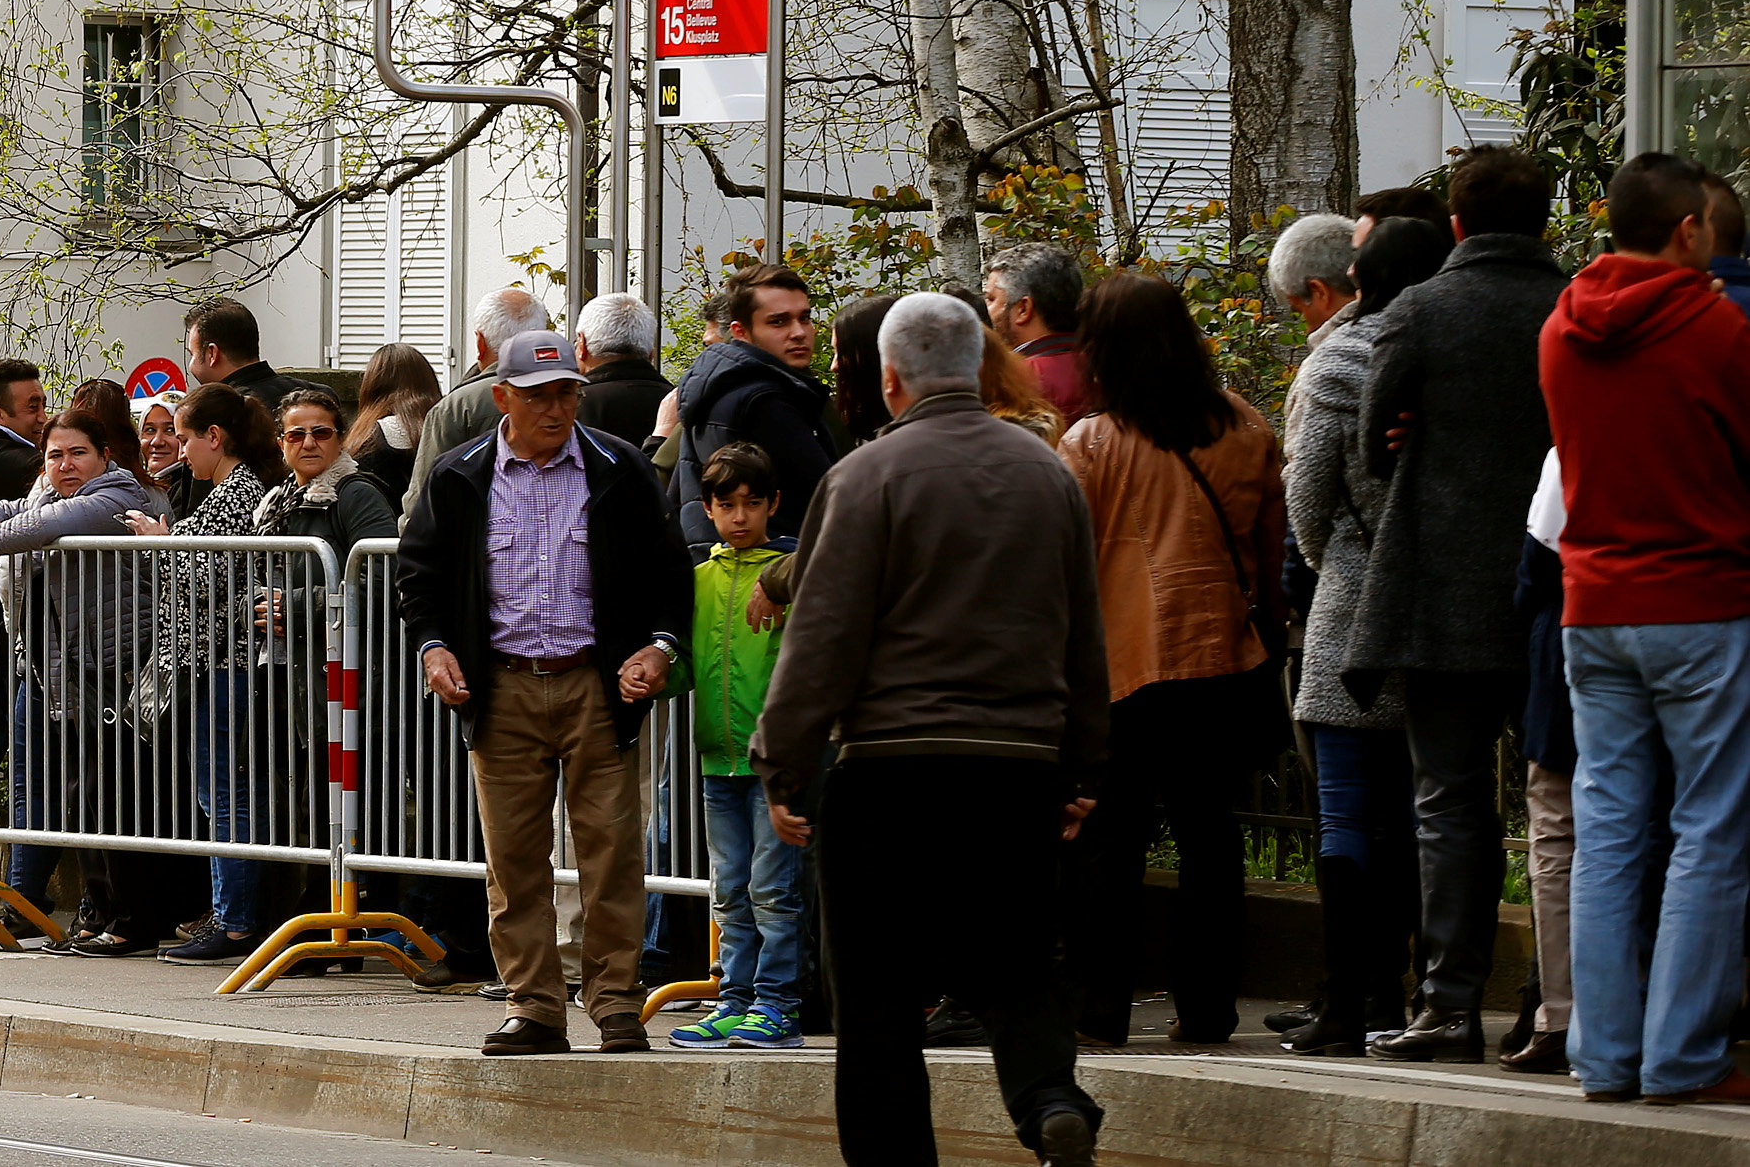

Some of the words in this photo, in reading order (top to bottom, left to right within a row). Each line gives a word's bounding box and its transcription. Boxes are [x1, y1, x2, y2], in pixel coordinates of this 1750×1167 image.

[660, 6, 685, 45] 15
[686, 14, 717, 27] Bellevue
[685, 30, 720, 45] Klusplatz
[662, 86, 678, 106] N6
